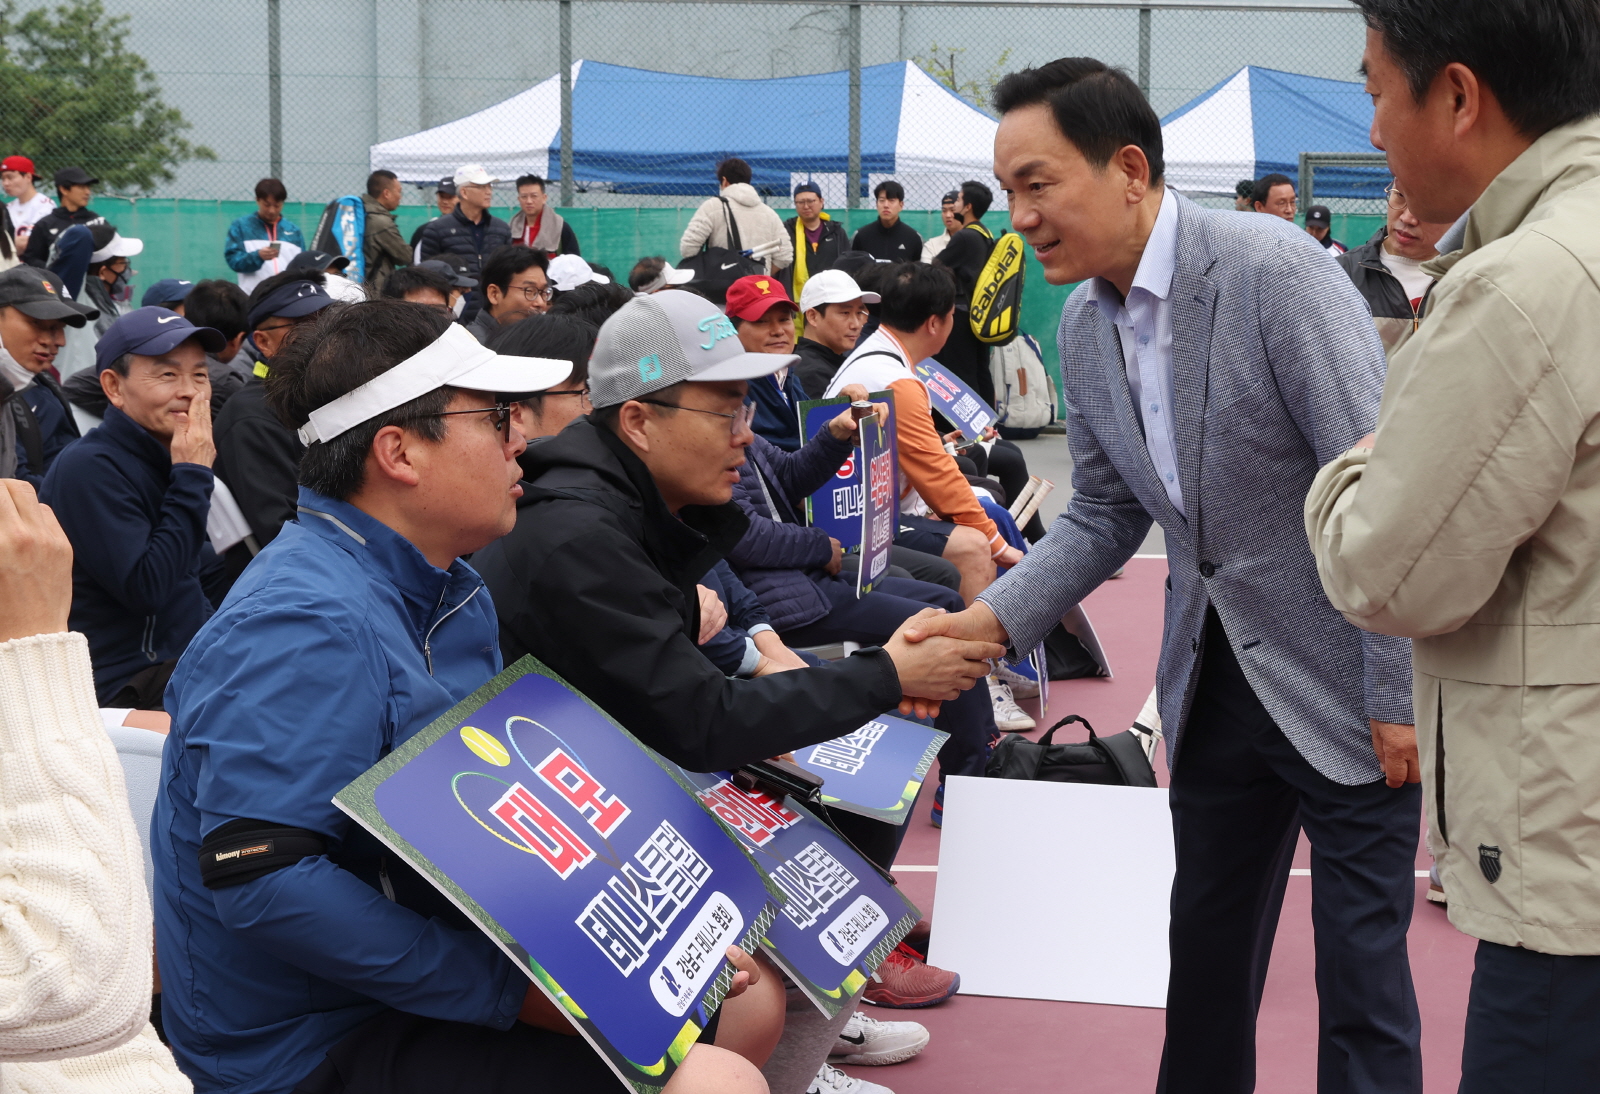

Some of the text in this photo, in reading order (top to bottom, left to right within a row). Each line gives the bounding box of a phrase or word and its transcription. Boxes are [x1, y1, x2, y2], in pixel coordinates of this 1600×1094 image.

[574, 819, 714, 978] 테니스클럽
[838, 922, 861, 945] 강남구
[851, 912, 872, 932] 테니스
[676, 903, 734, 980] 강남구 테니스 협회
